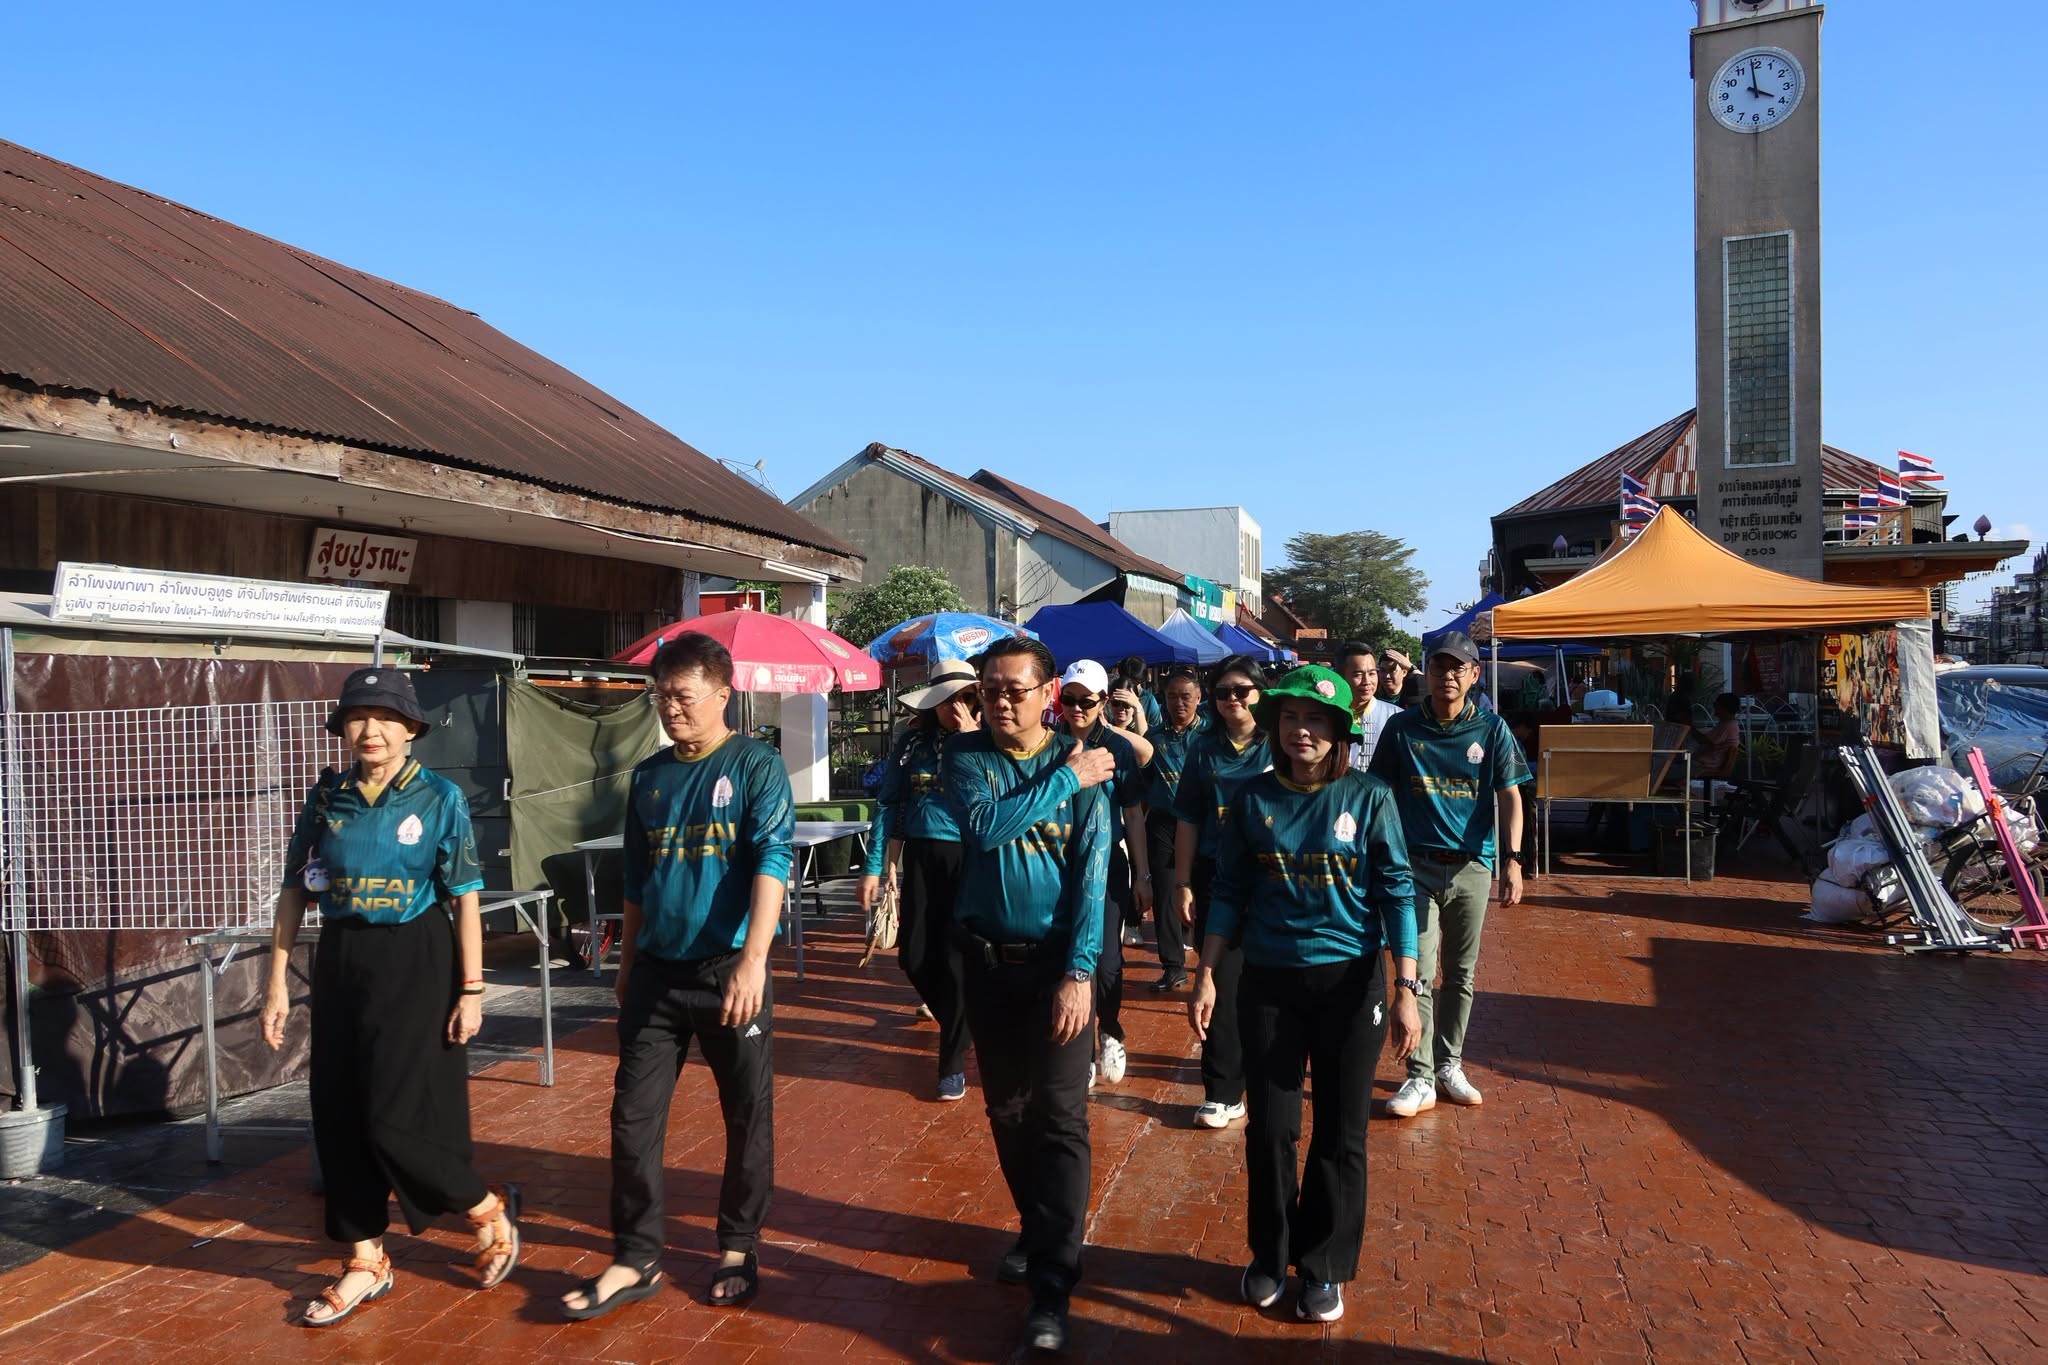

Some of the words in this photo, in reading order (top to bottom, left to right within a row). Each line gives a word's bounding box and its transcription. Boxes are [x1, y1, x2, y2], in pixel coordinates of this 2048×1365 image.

[1767, 62, 1773, 70] 1
[1735, 67, 1745, 76] 11
[1778, 69, 1786, 78] 2
[1726, 79, 1737, 88] 10
[1783, 82, 1790, 90] 3
[1722, 92, 1729, 101] 9
[1778, 96, 1785, 105] 4
[1726, 105, 1734, 113] 8
[1767, 107, 1775, 116] 5
[1738, 112, 1745, 121] 7
[1752, 113, 1759, 122] 6
[1744, 547, 1776, 556] 2503
[68, 573, 155, 593] ลำโพงพกพา
